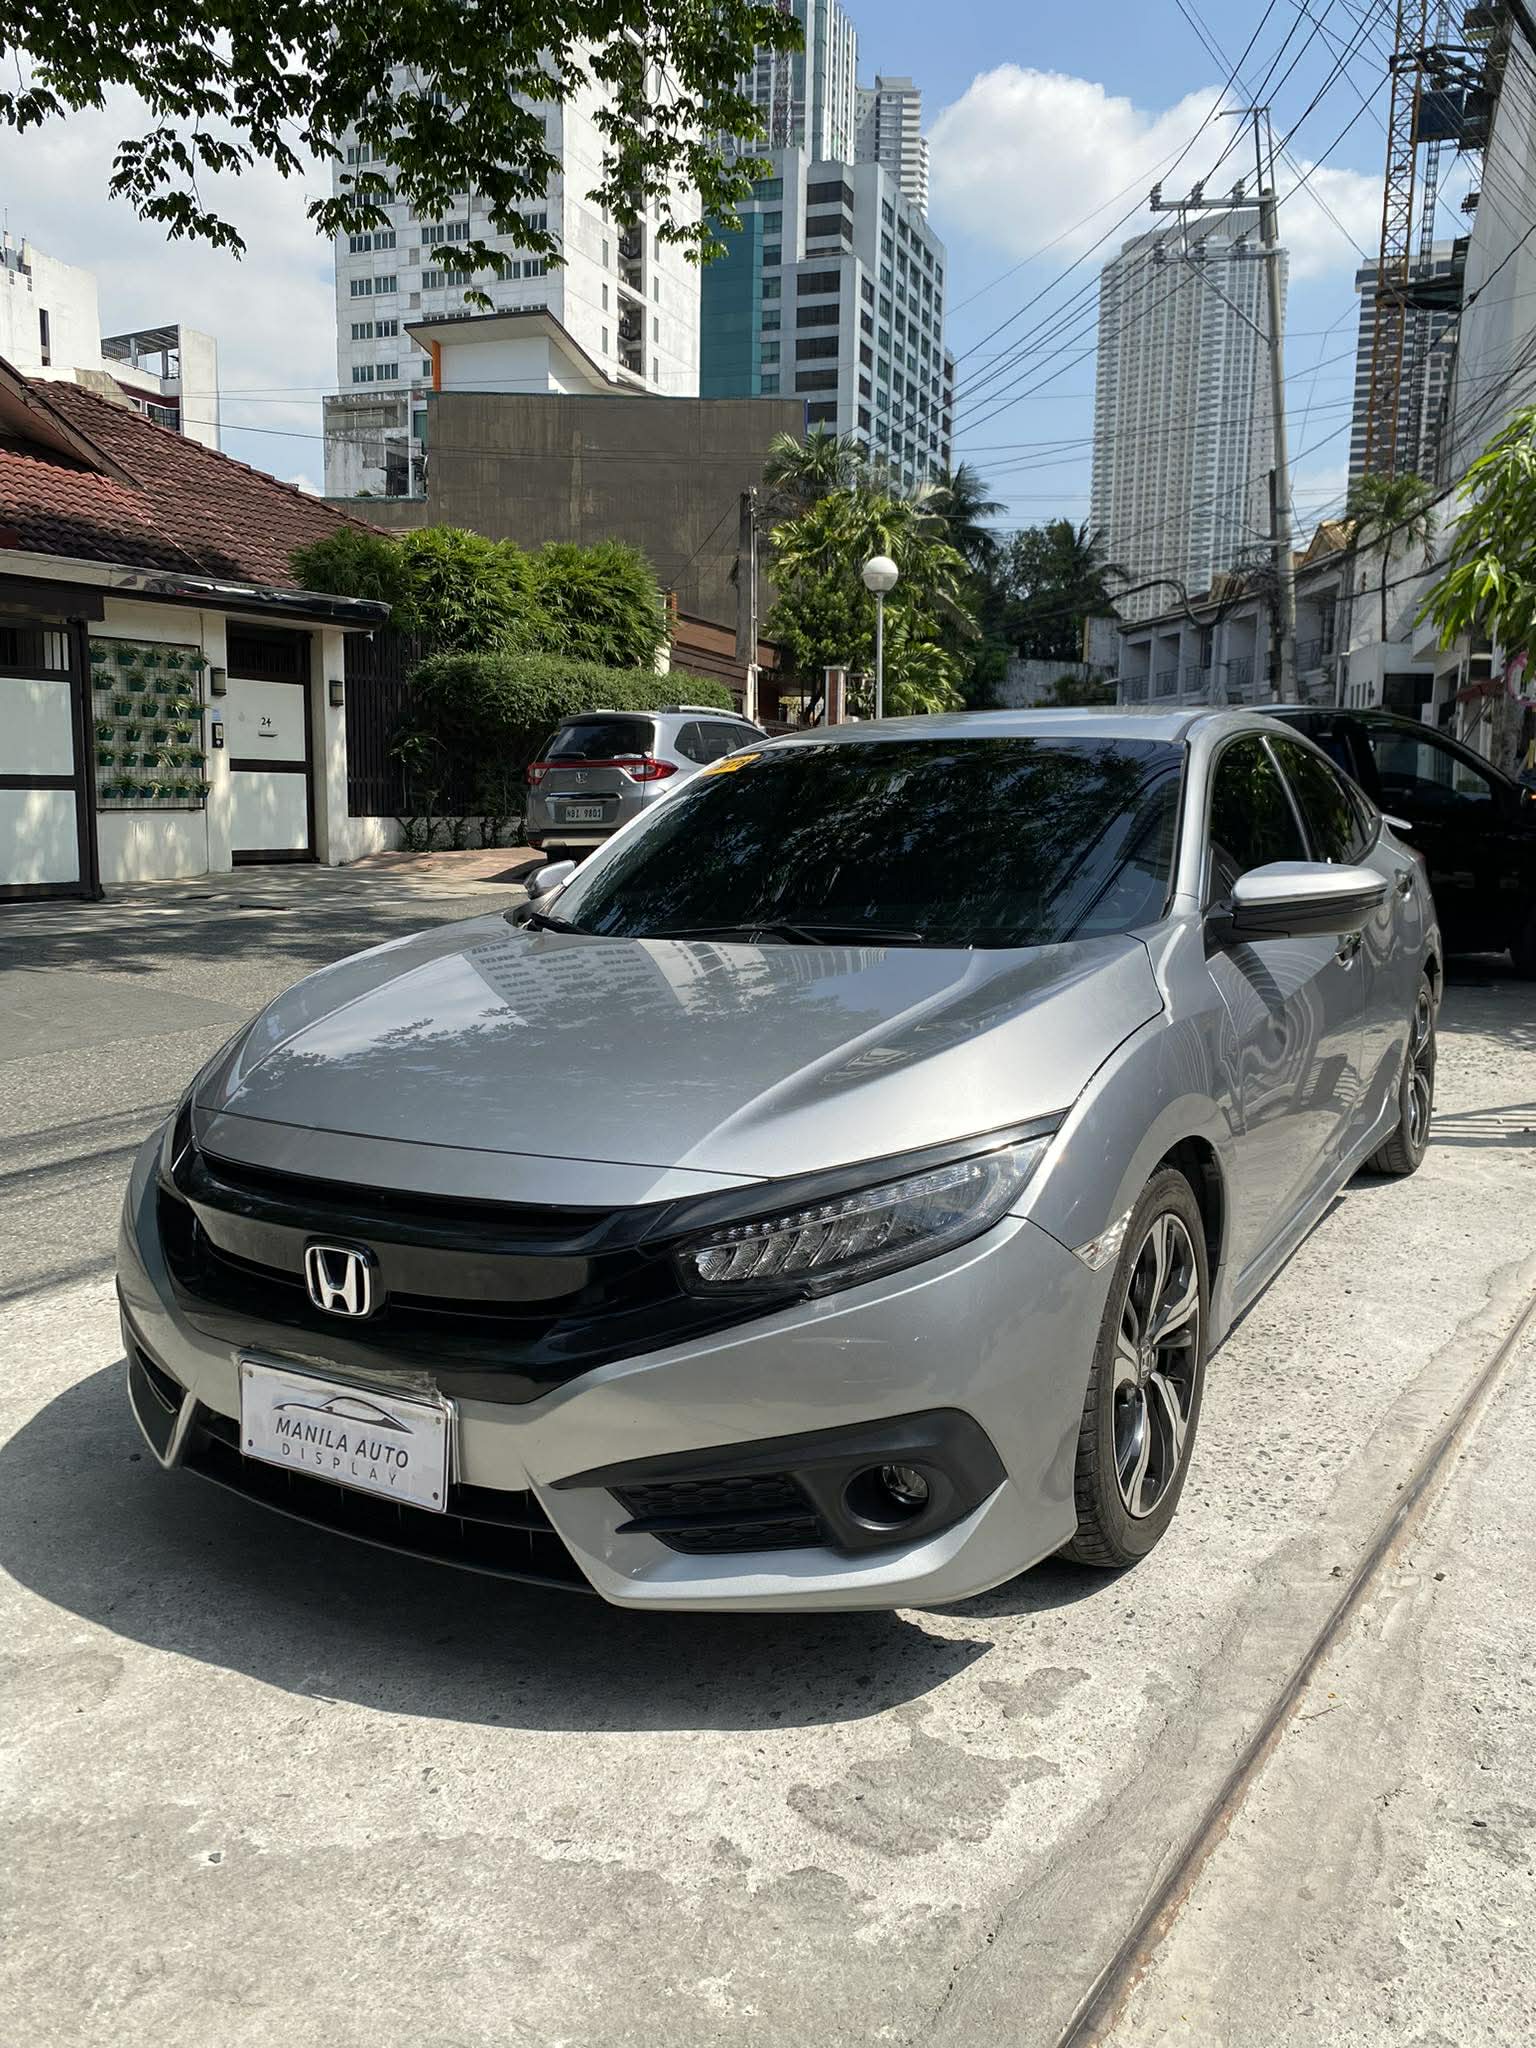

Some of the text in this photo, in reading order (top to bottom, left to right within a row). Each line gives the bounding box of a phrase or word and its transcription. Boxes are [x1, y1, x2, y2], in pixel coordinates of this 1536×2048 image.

[261, 716, 272, 728] 24
[275, 1417, 409, 1469] MANILA AUTO
[282, 1442, 396, 1486] DISPLAY
